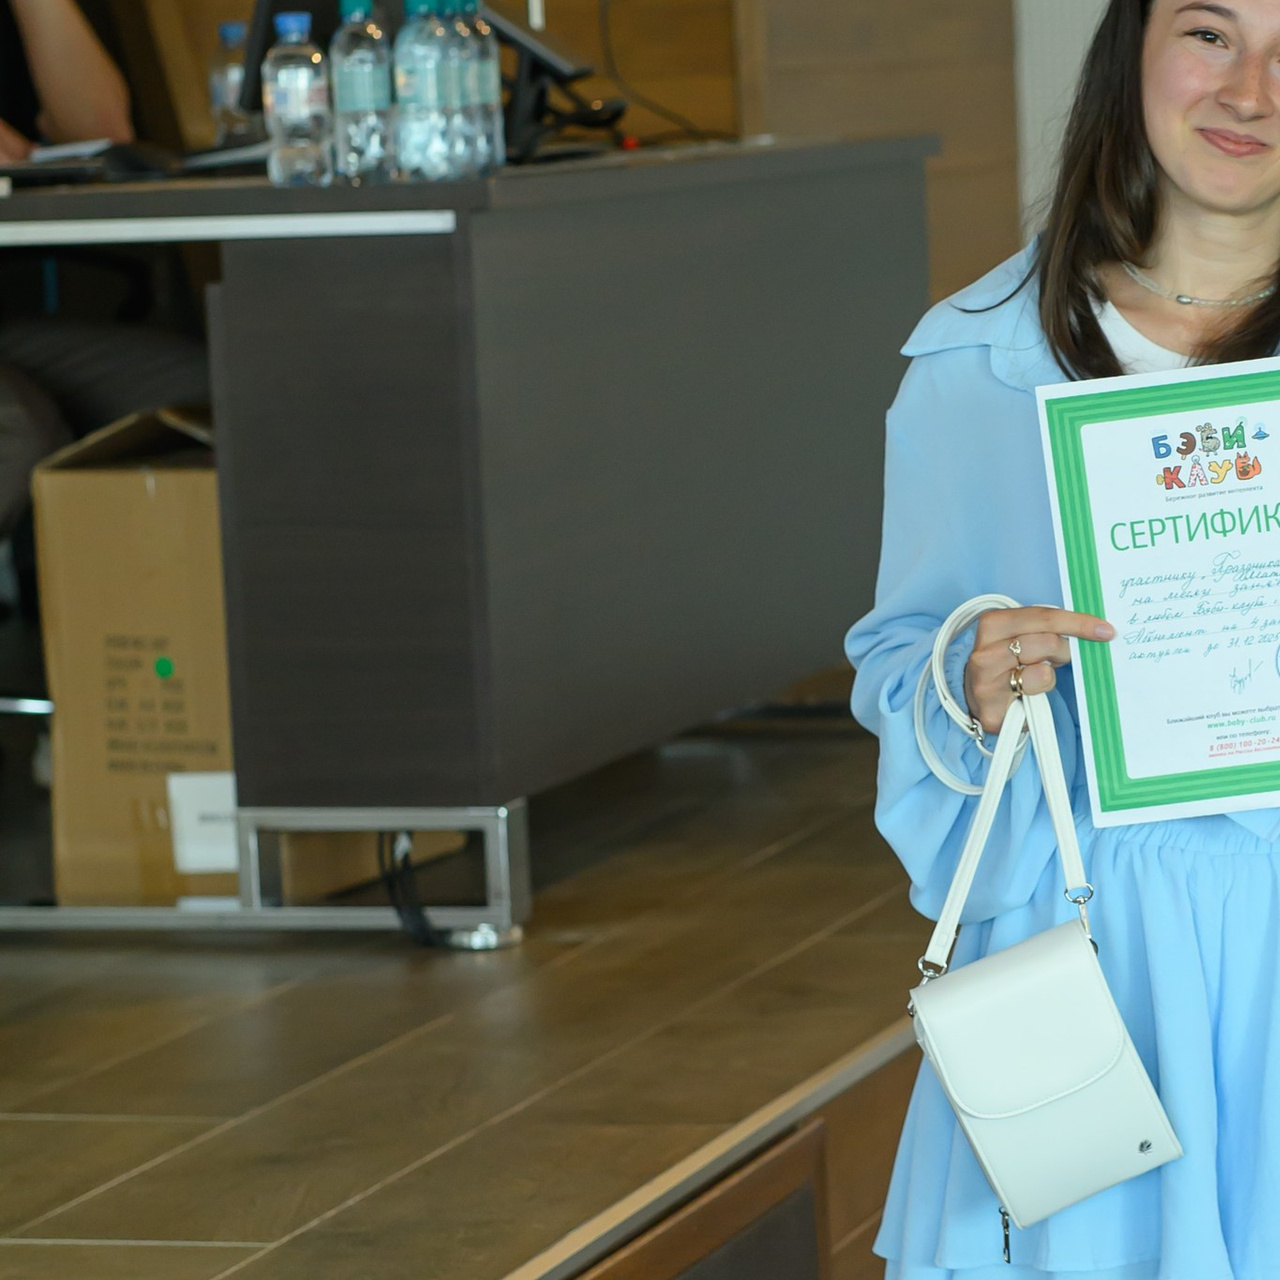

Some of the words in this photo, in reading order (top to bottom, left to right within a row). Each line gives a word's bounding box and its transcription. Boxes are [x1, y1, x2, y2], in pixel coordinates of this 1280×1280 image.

[1151, 422, 1247, 459] БЭБИ
[1158, 452, 1262, 490] КЛУБ
[1119, 571, 1196, 599] участнику
[1131, 596, 1152, 606] на
[1127, 613, 1138, 624] в
[1222, 624, 1238, 632] на
[1250, 617, 1259, 628] 4
[1203, 643, 1220, 657] до
[1207, 715, 1277, 729] www.baby-club.ru
